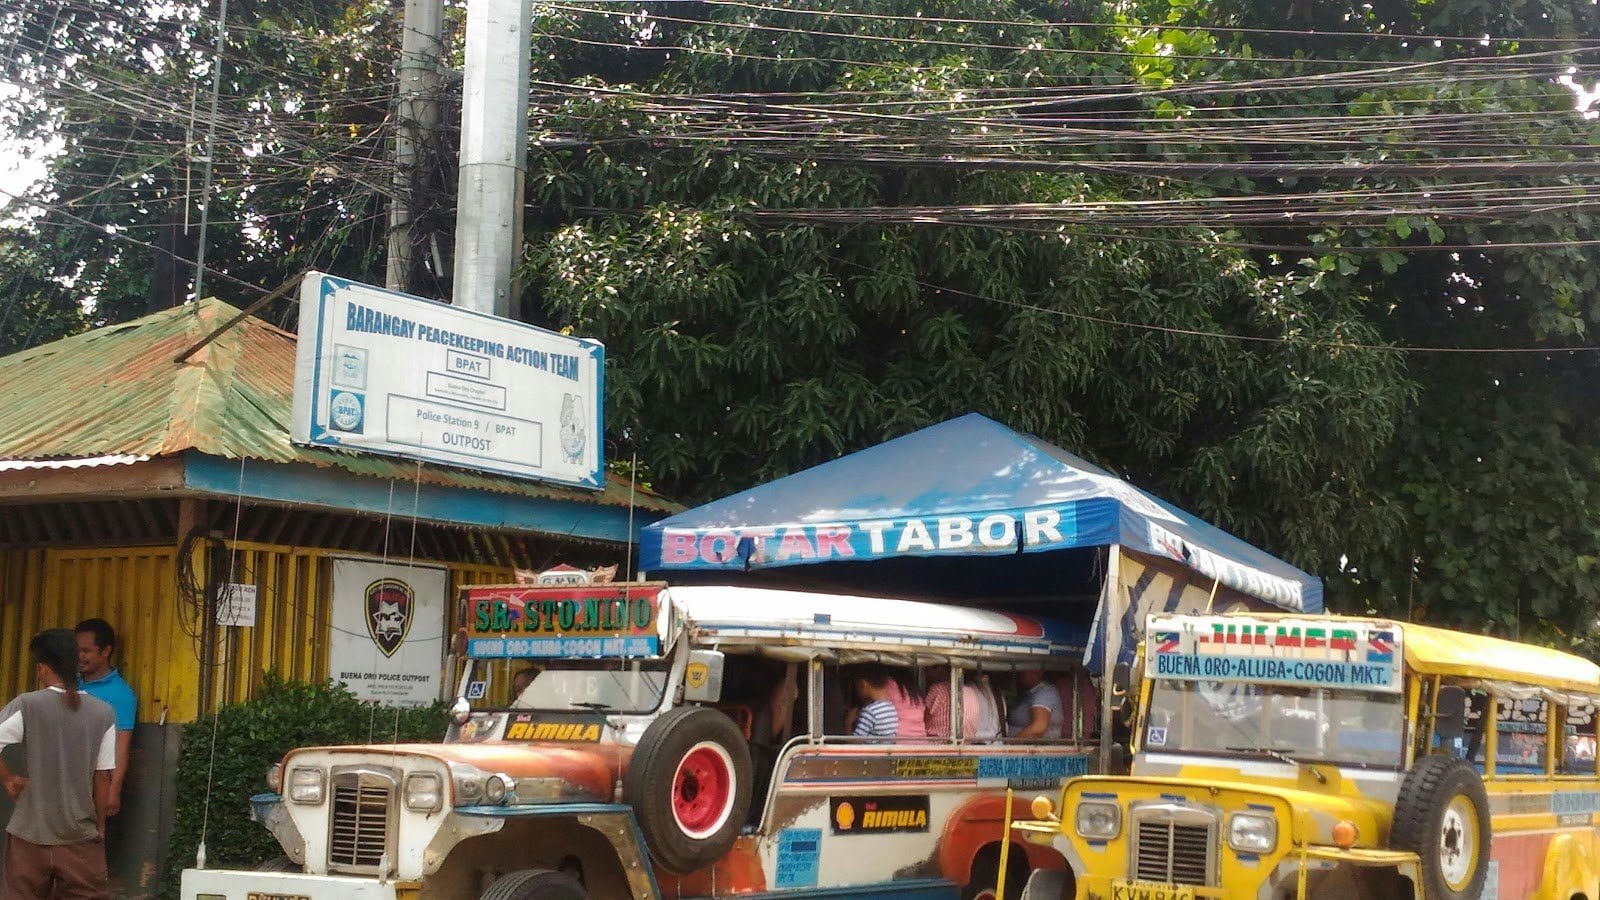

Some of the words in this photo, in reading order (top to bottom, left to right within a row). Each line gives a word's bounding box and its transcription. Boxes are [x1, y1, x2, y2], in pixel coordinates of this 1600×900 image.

[346, 301, 416, 339] BARANGAY
[418, 323, 504, 358] PEACEKEEPING
[506, 345, 548, 371] ACTION
[550, 353, 579, 382] TEAM
[456, 357, 482, 373] BPAT
[416, 409, 442, 423] Police
[443, 414, 472, 428] Station
[474, 420, 479, 430] 9
[495, 424, 516, 436] BPAT
[442, 431, 492, 451] OUTPOST
[859, 509, 1065, 553] TABOR
[340, 672, 362, 680] BUENA
[363, 672, 377, 680] ORO
[379, 673, 400, 682] POLICE
[402, 674, 430, 683] OUTPOST
[1158, 654, 1200, 675] BUENA
[1351, 666, 1388, 685] MKT.
[507, 723, 600, 741] RIMULA
[862, 810, 926, 828] RIMULA
